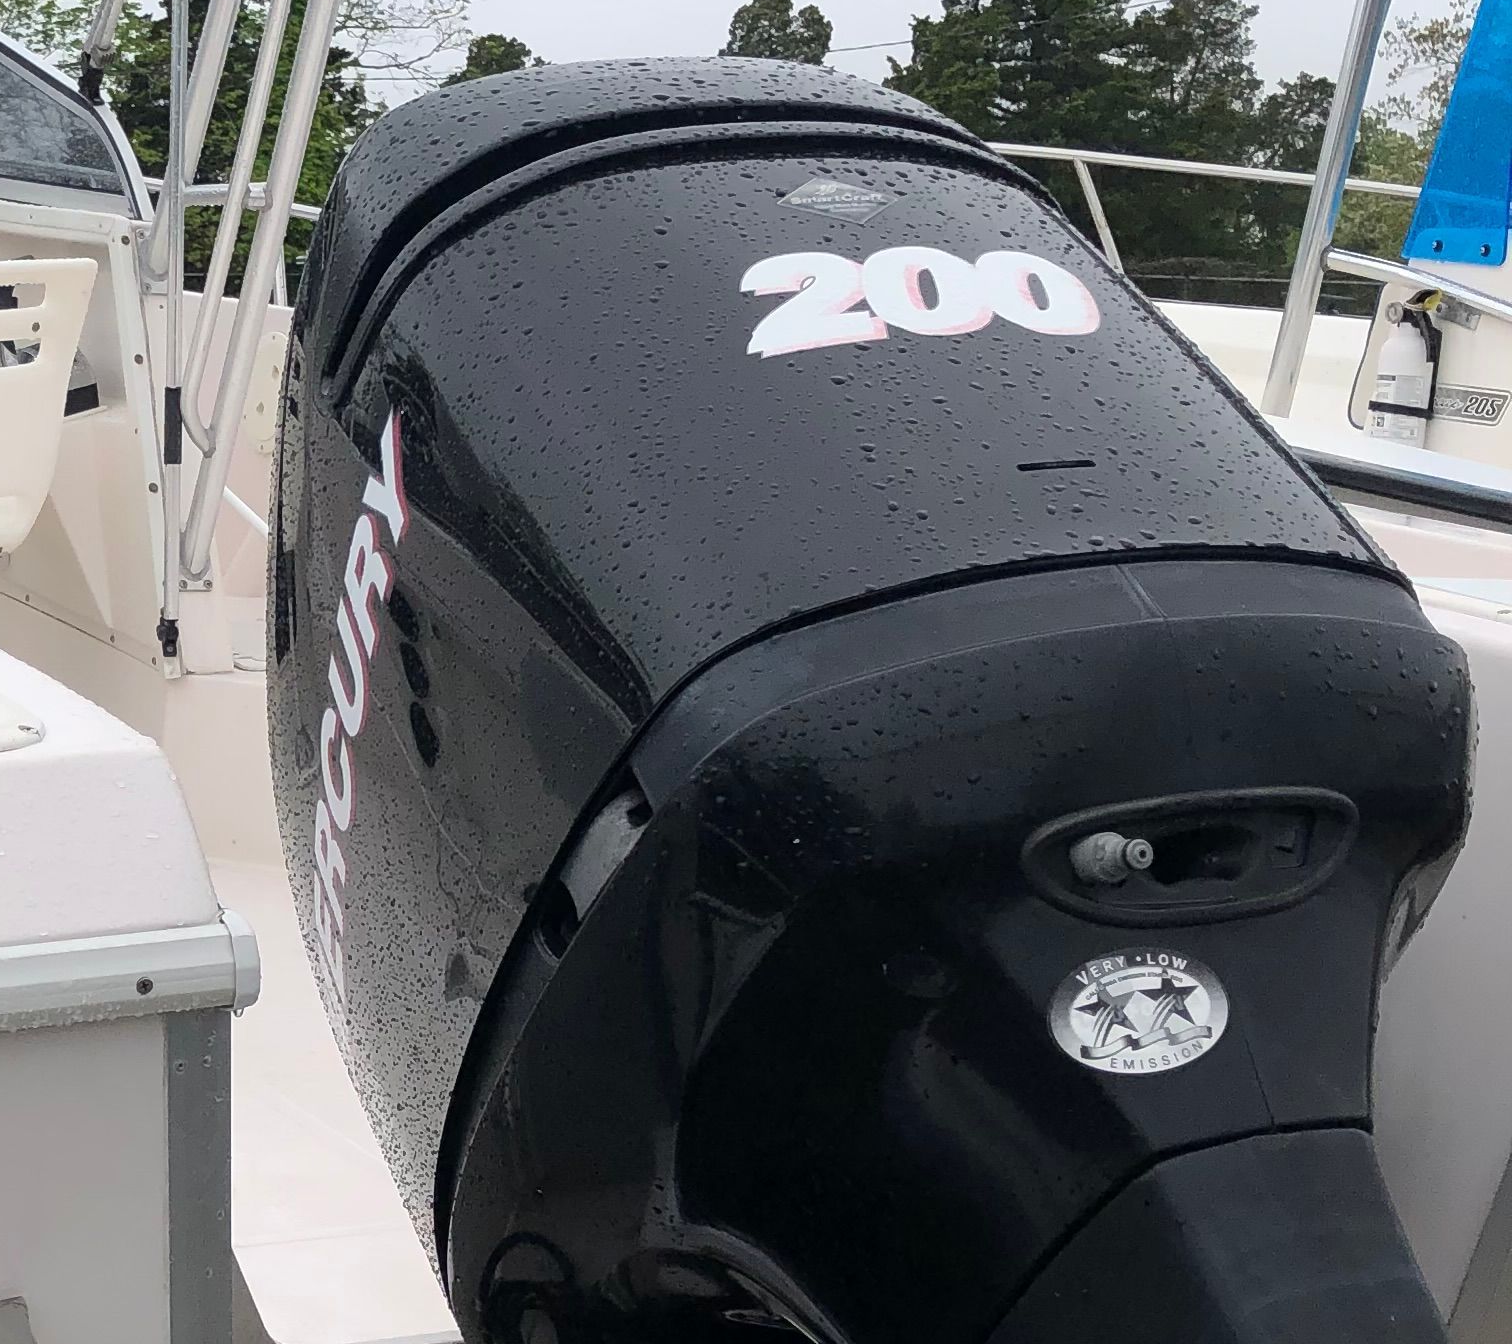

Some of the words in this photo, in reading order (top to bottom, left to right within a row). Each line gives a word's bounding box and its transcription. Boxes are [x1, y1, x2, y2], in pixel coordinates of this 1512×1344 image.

[739, 246, 1101, 359] 200
[1462, 395, 1503, 417] 205
[1075, 955, 1126, 986] VERY
[1146, 953, 1188, 970] LOW
[1110, 1040, 1204, 1070] EMISSION
